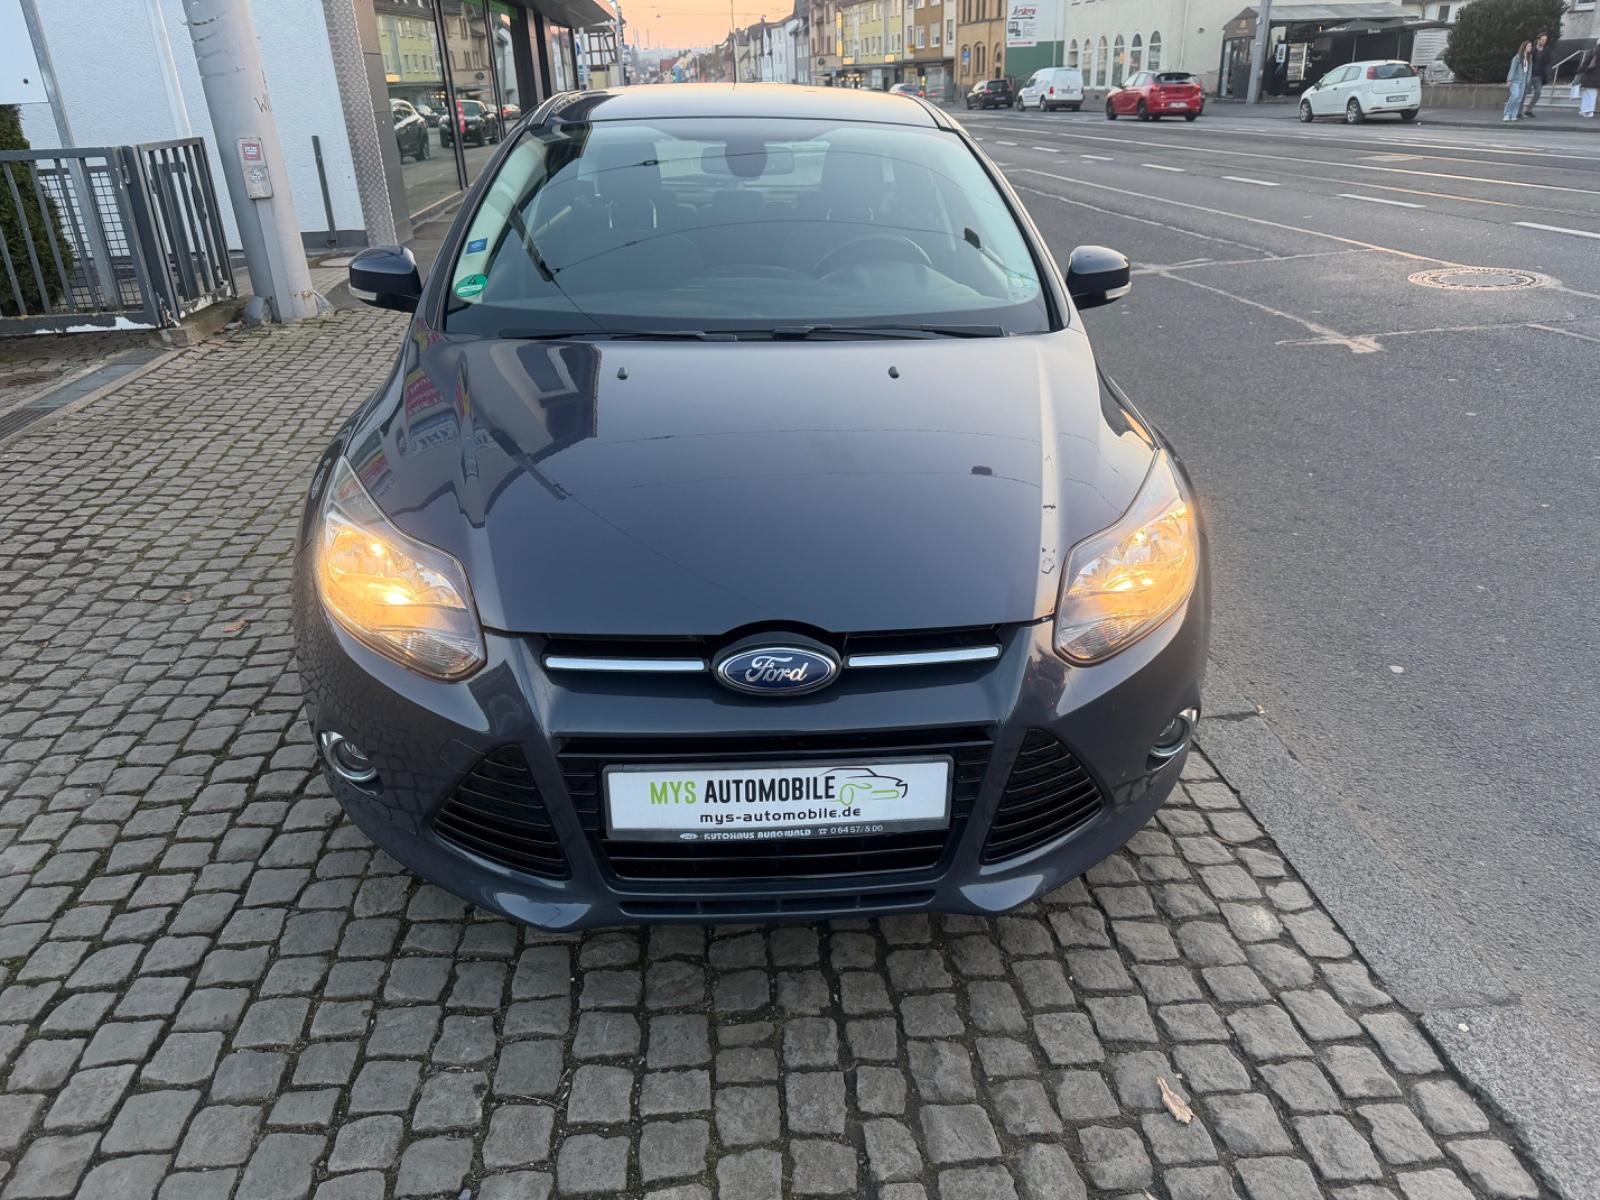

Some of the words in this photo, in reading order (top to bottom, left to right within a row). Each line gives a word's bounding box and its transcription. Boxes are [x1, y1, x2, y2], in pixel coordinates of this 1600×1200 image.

[744, 655, 809, 683] Ford
[649, 780, 697, 805] MYS
[704, 775, 836, 804] AUTOMOBILE
[699, 806, 861, 825] mys-automobile.de
